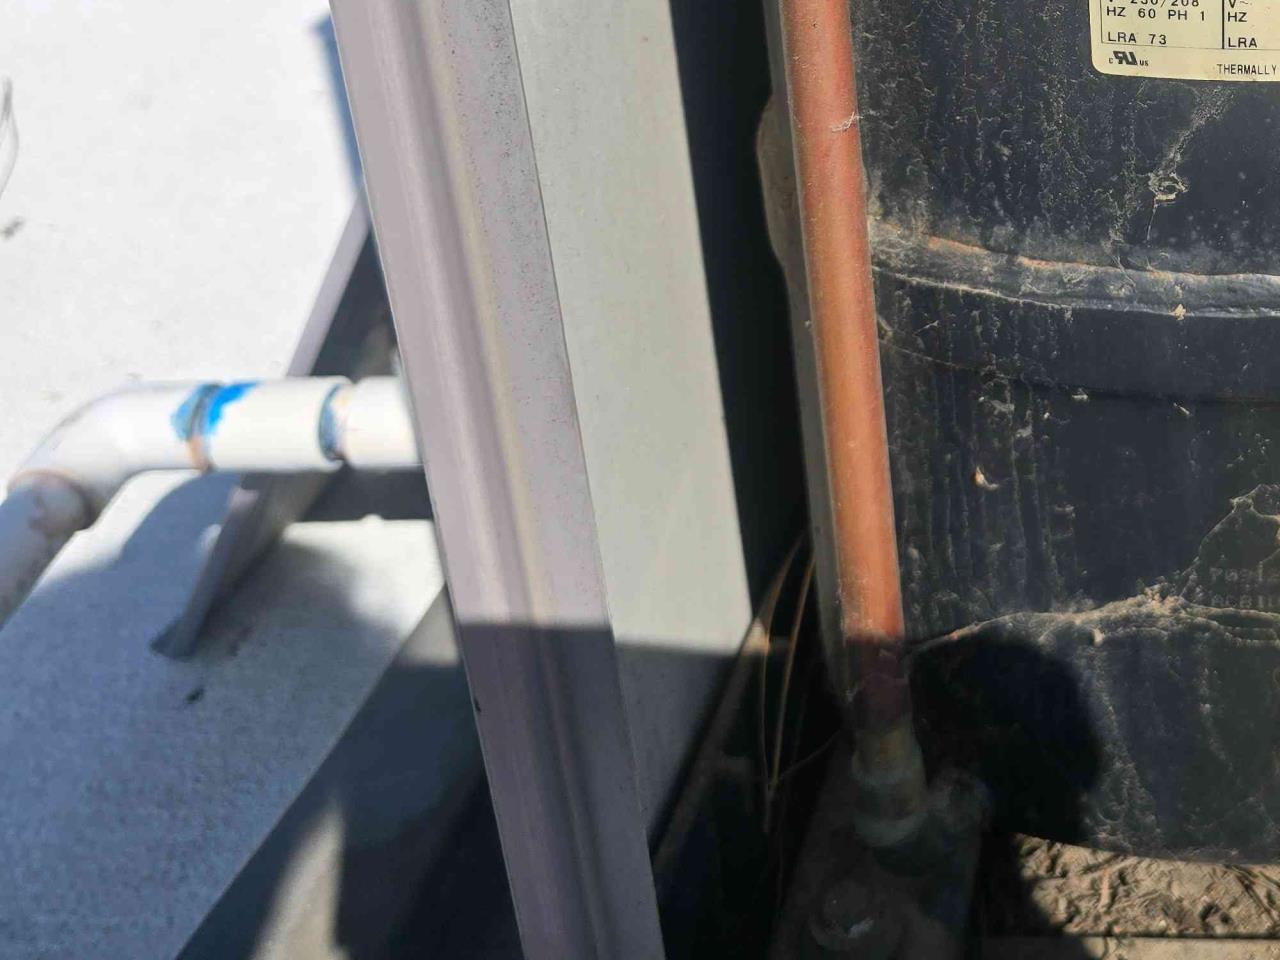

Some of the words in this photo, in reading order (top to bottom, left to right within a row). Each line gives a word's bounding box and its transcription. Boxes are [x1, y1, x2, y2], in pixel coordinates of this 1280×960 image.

[1106, 6, 1127, 18] HZ
[1138, 8, 1157, 19] 60
[1167, 9, 1188, 21] PH
[1199, 11, 1206, 21] 1
[1227, 11, 1248, 23] HZ
[1107, 31, 1138, 44] LRA
[1148, 33, 1168, 45] 73
[1227, 37, 1258, 48] LRA
[1216, 63, 1277, 76] THERMALLY
